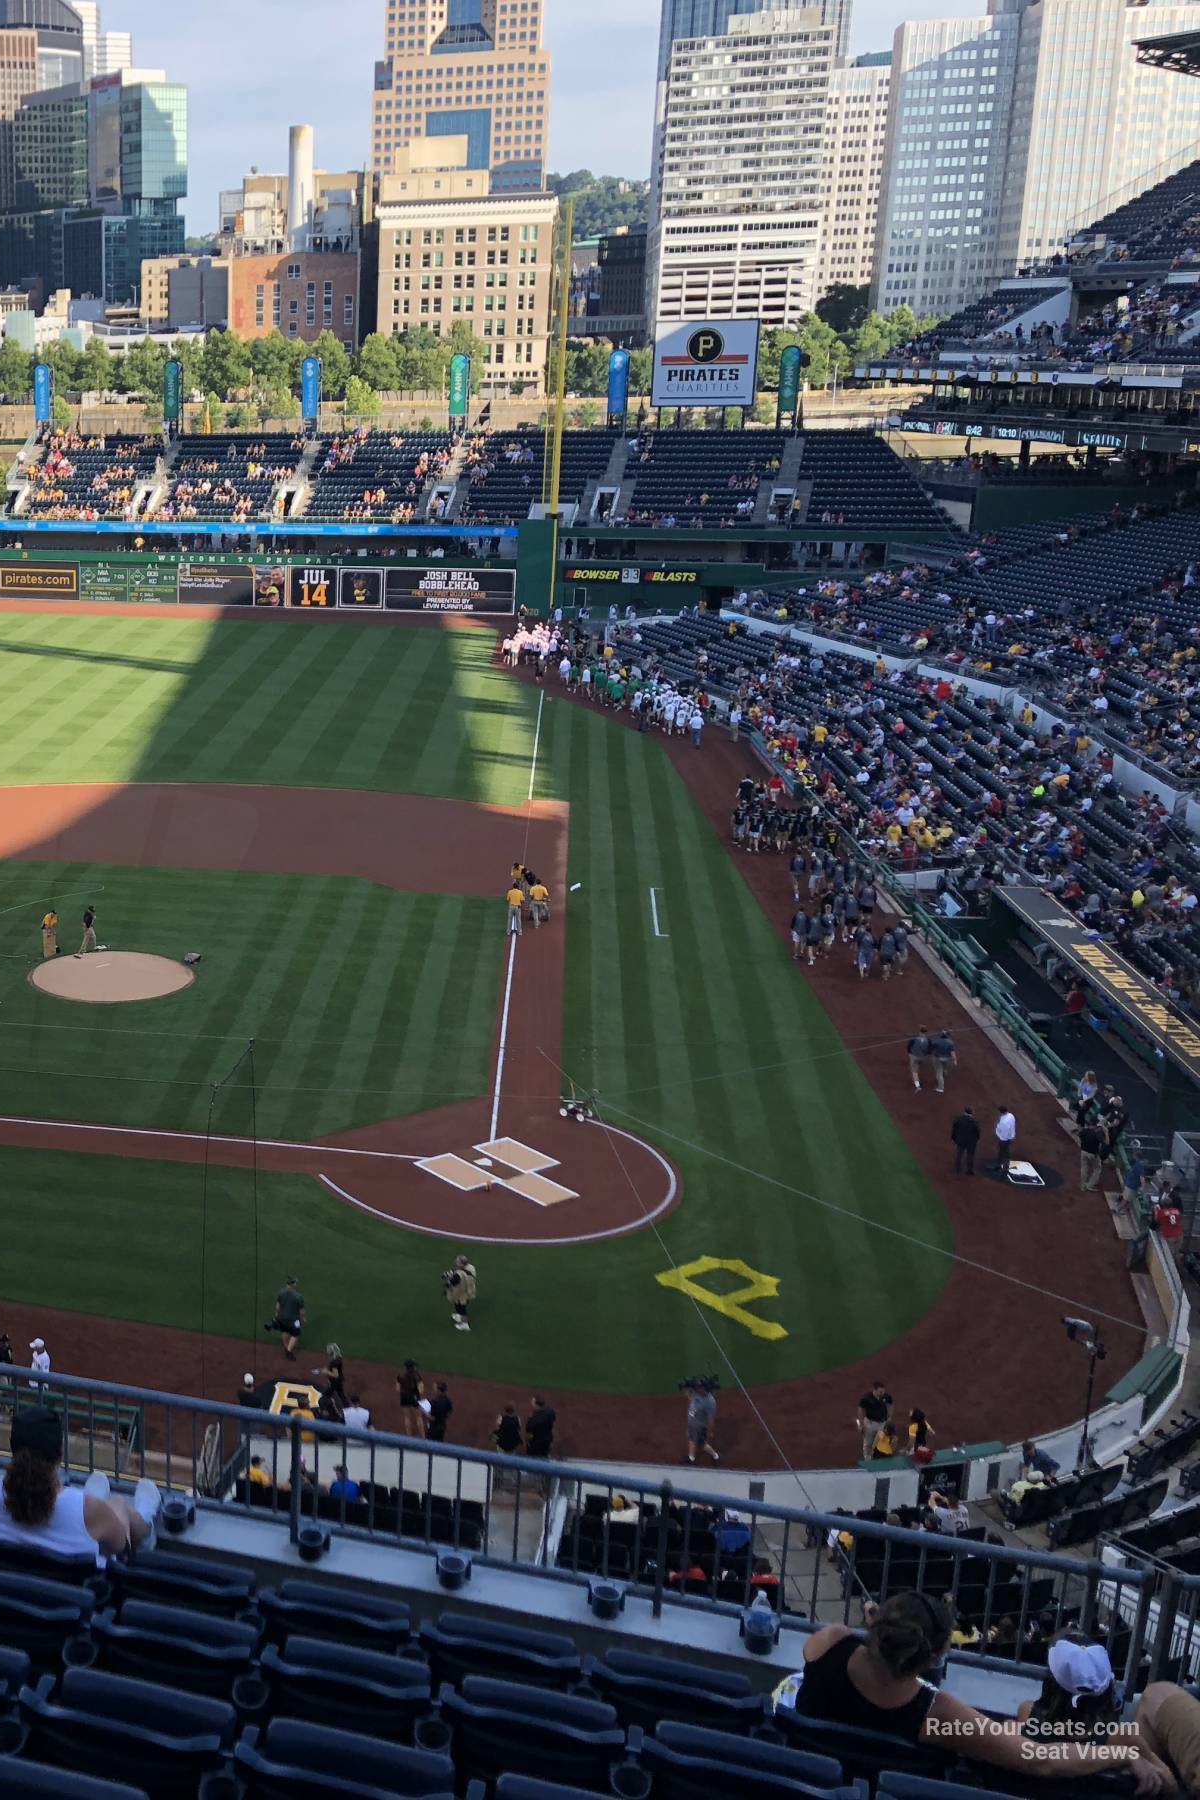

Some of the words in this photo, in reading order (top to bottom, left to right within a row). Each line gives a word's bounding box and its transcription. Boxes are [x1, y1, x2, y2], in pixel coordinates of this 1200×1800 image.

[697, 335, 714, 357] P
[667, 368, 740, 382] PIRATES
[666, 382, 740, 393] CHARITIES
[965, 425, 982, 435] 6:42
[998, 427, 1017, 438] 10:10
[157, 555, 226, 563] WELCOME
[5, 572, 70, 586] pirates.com
[299, 569, 330, 585] JUL
[424, 571, 448, 581] JOSH
[451, 572, 475, 581] BELL
[573, 569, 620, 579] BOWSER
[652, 571, 697, 582] BLASTS
[418, 580, 480, 591] BOBBLEHEAD
[301, 583, 328, 606] 14
